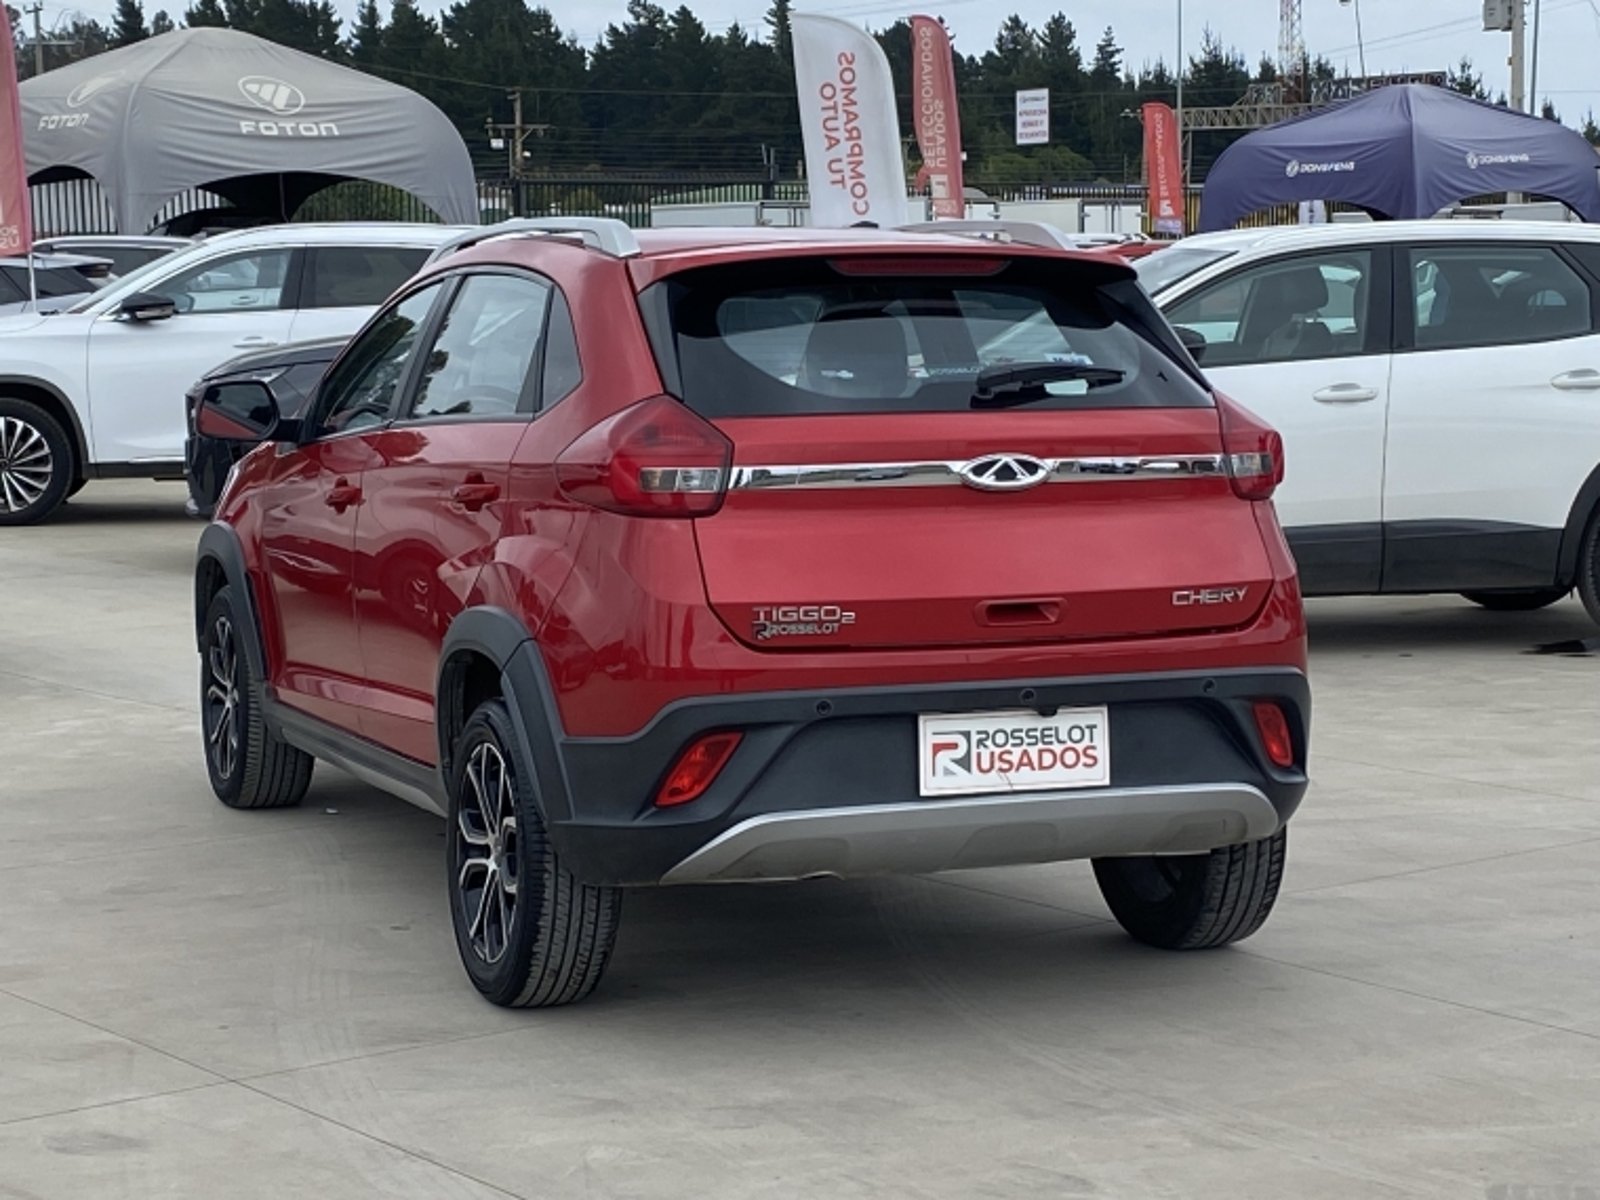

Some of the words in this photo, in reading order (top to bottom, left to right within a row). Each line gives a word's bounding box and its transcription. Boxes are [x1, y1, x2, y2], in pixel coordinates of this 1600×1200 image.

[38, 112, 90, 131] FOTON
[239, 121, 340, 137] FOTON
[1172, 585, 1249, 606] CHERY
[975, 724, 1098, 750] ROSSELOT
[975, 745, 1099, 775] USADOS
